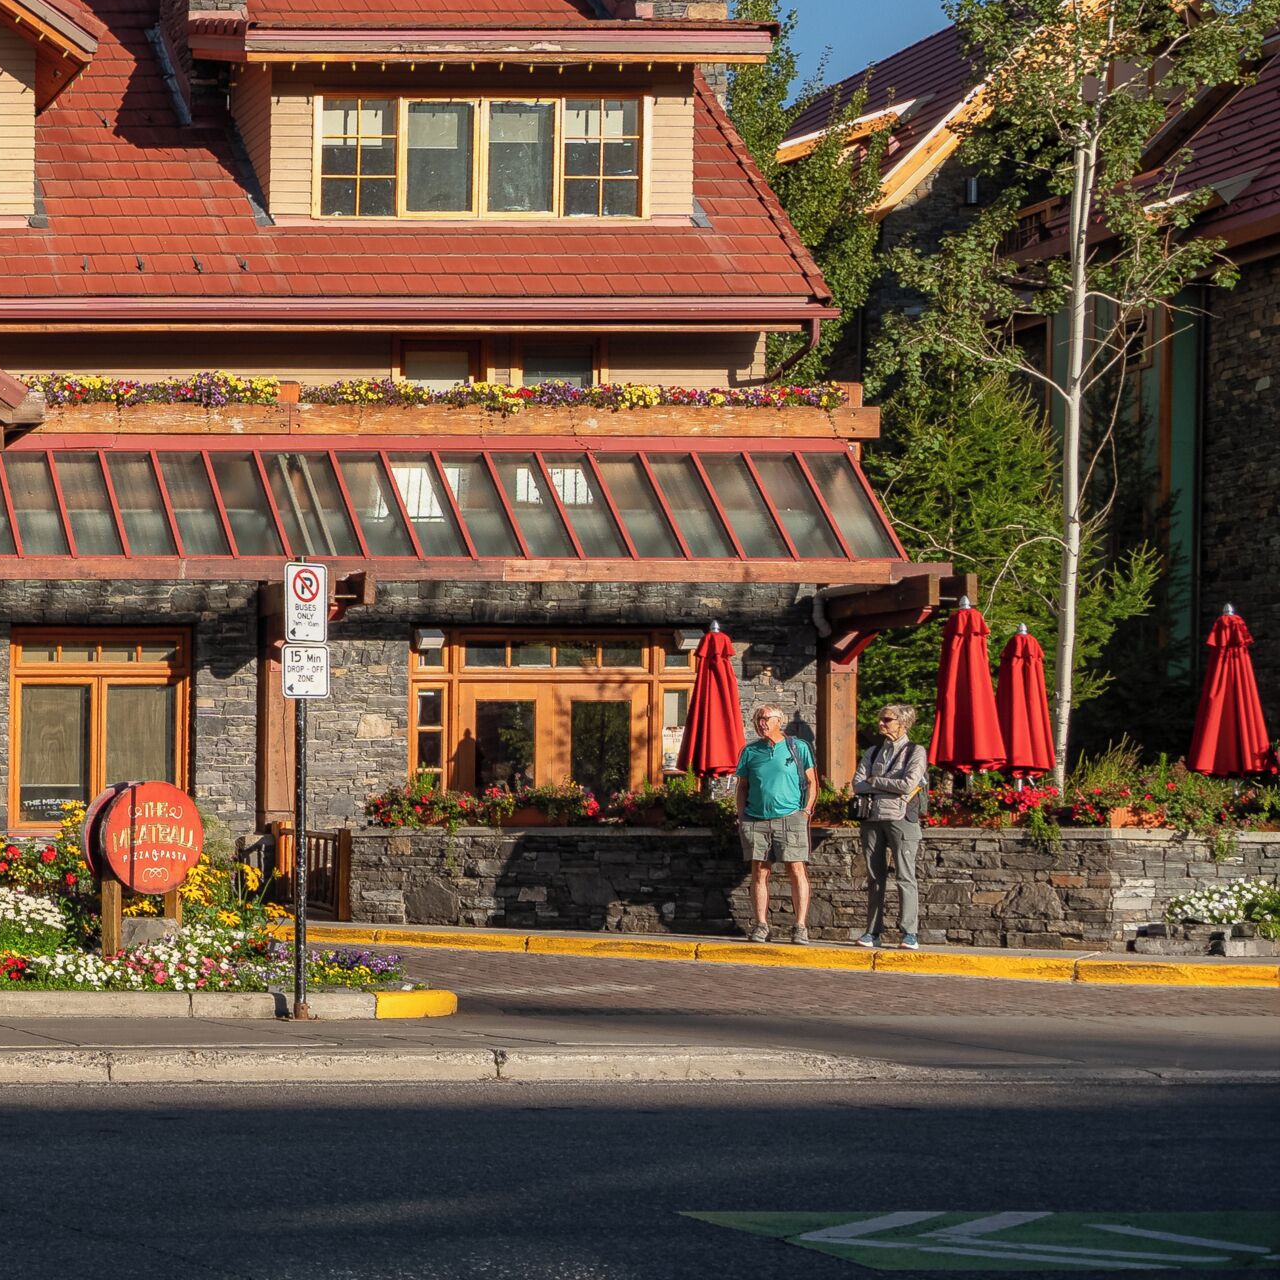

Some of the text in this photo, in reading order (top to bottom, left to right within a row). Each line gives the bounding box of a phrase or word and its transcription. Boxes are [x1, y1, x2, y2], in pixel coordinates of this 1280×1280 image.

[294, 603, 317, 612] BUSES
[296, 612, 314, 620] ONLY
[290, 651, 322, 663] 15 Min
[142, 802, 168, 818] THE
[112, 823, 198, 853] MEATBALL
[122, 850, 150, 862] PZZA
[160, 850, 187, 862] PASTA
